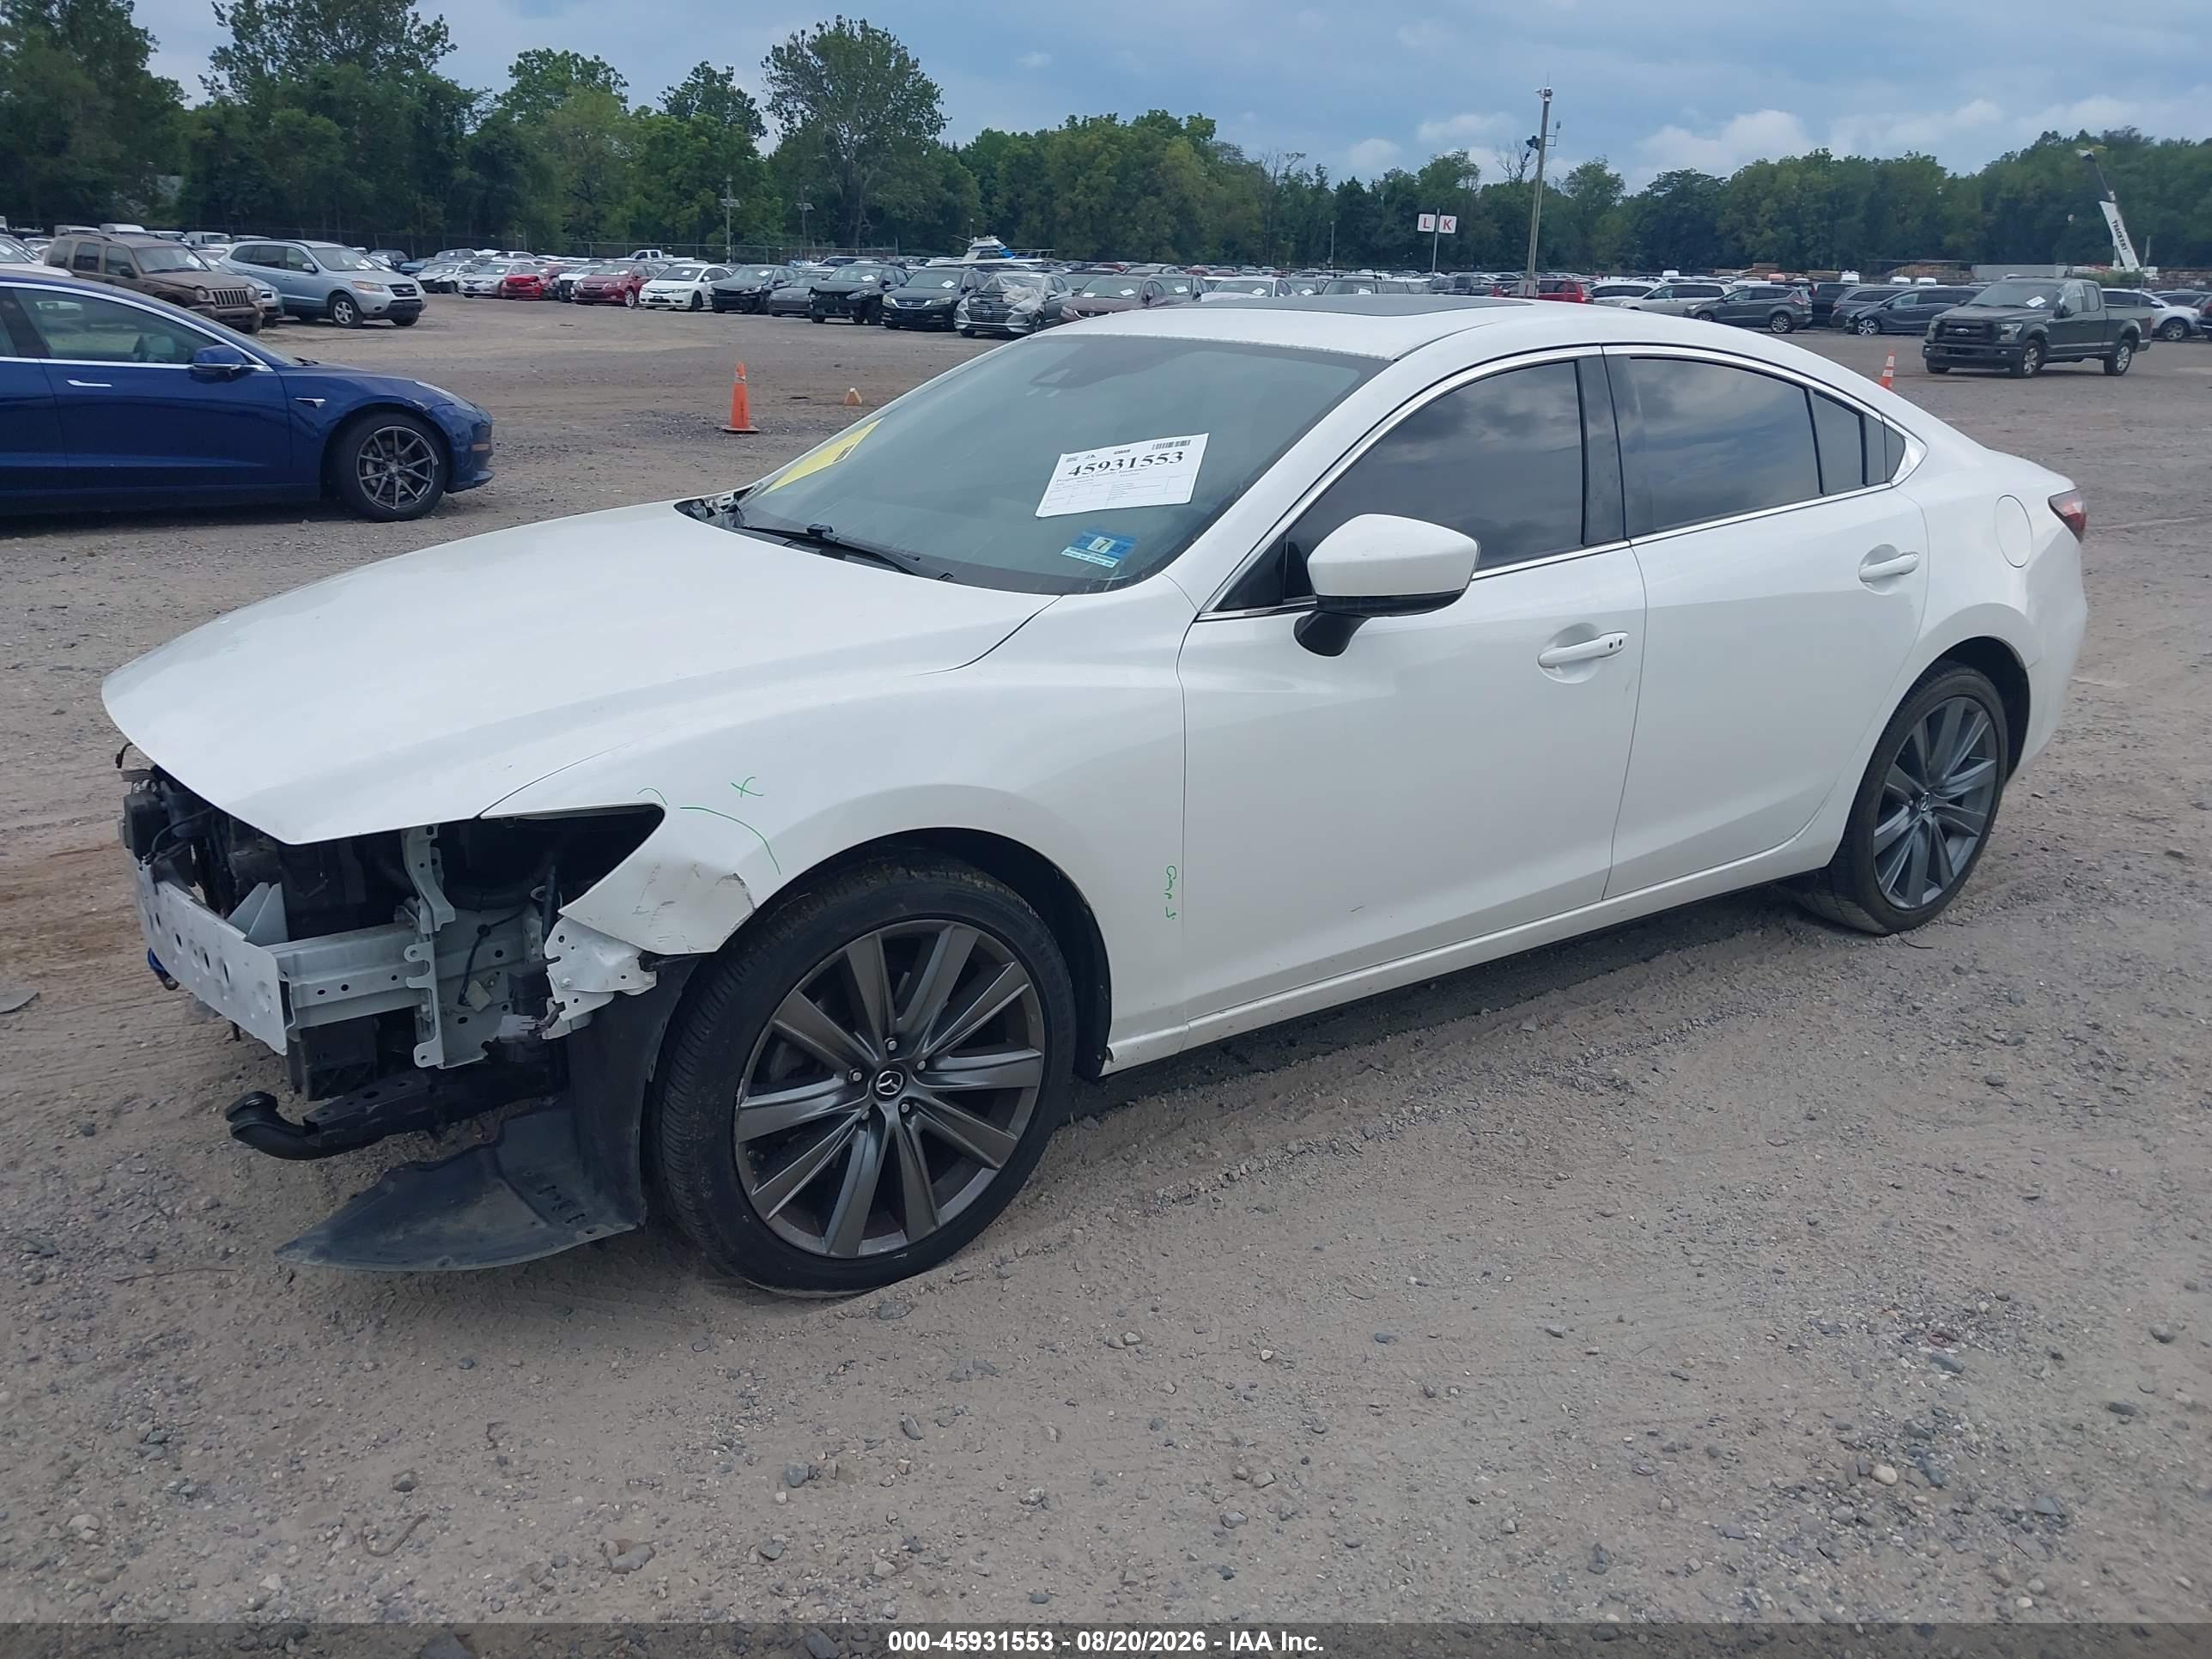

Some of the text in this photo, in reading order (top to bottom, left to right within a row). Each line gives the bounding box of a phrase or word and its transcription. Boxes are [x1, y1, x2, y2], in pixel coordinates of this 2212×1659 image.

[1423, 217, 1431, 228] L
[1443, 219, 1452, 230] K
[1068, 451, 1183, 476] 45931553
[1097, 538, 1111, 550] 7
